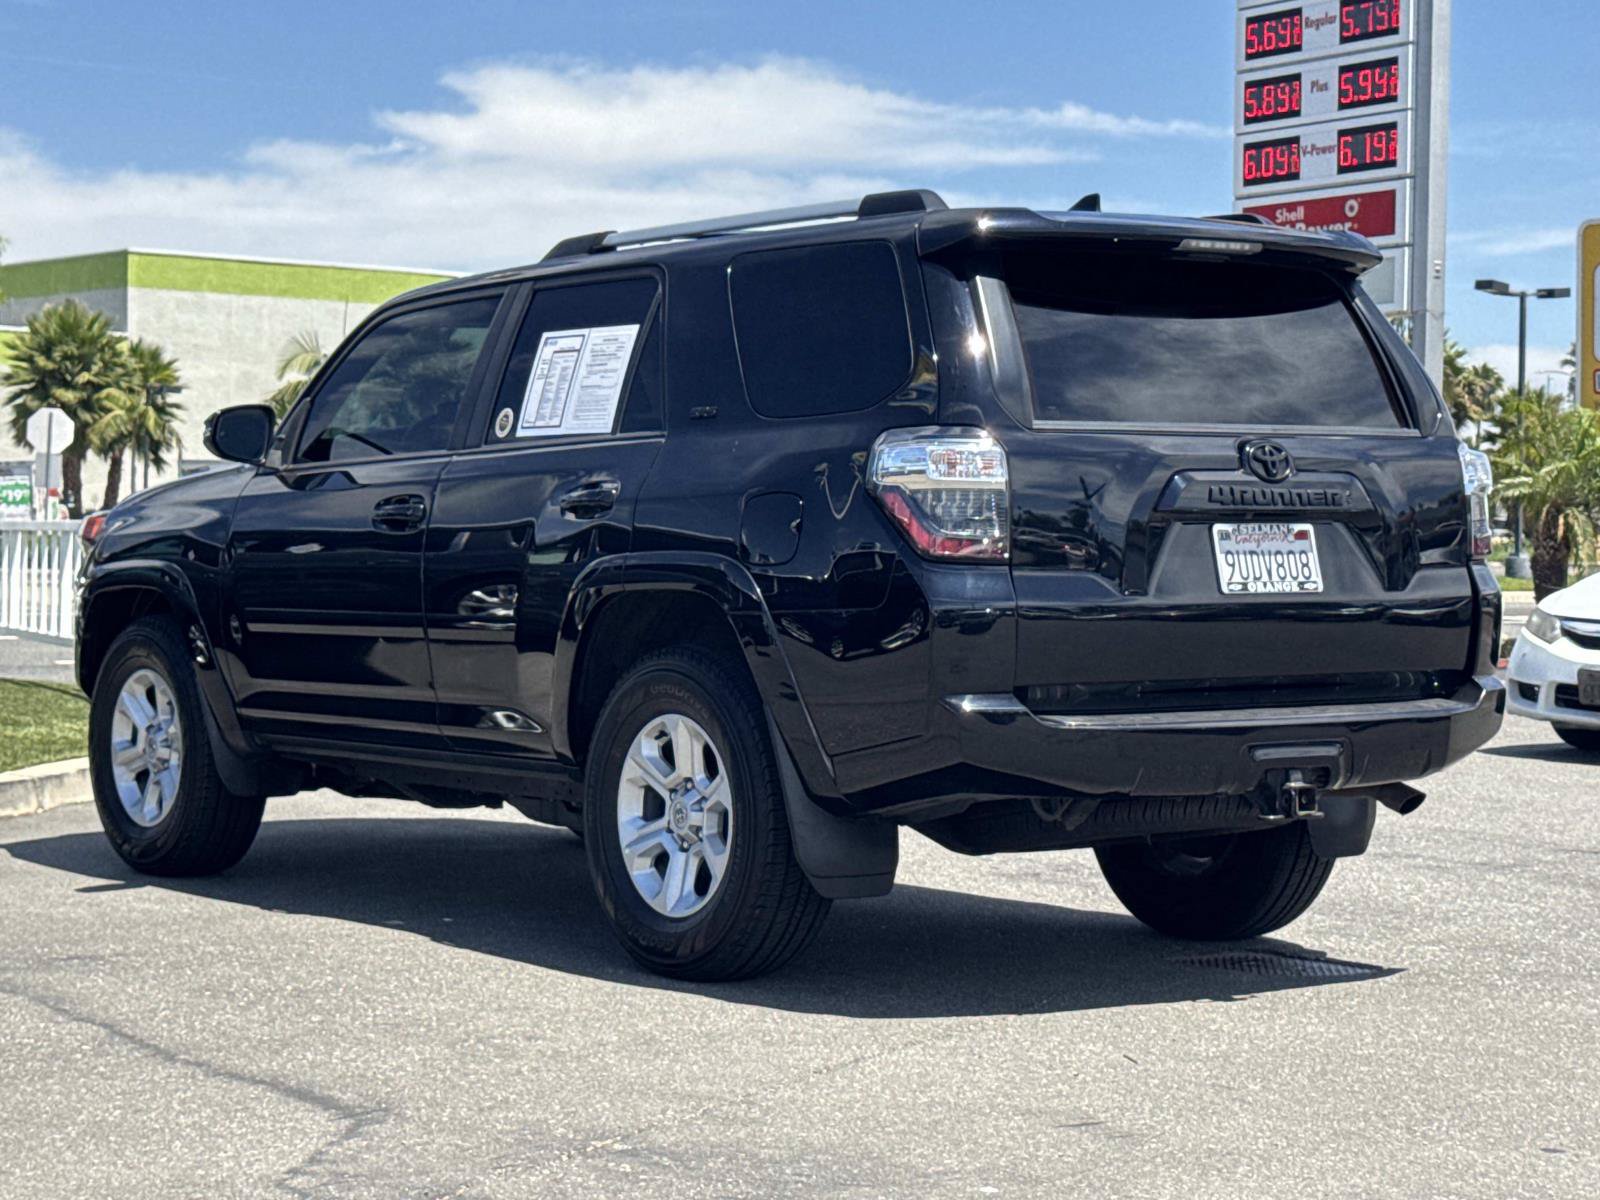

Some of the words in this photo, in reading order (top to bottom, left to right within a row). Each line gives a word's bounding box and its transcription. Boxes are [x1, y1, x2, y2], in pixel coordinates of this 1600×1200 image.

[1304, 11, 1337, 31] Regular
[1310, 79, 1329, 93] Plus
[1302, 143, 1336, 157] V-Power
[1275, 205, 1305, 224] Shell
[1225, 550, 1312, 582] 9UDV808
